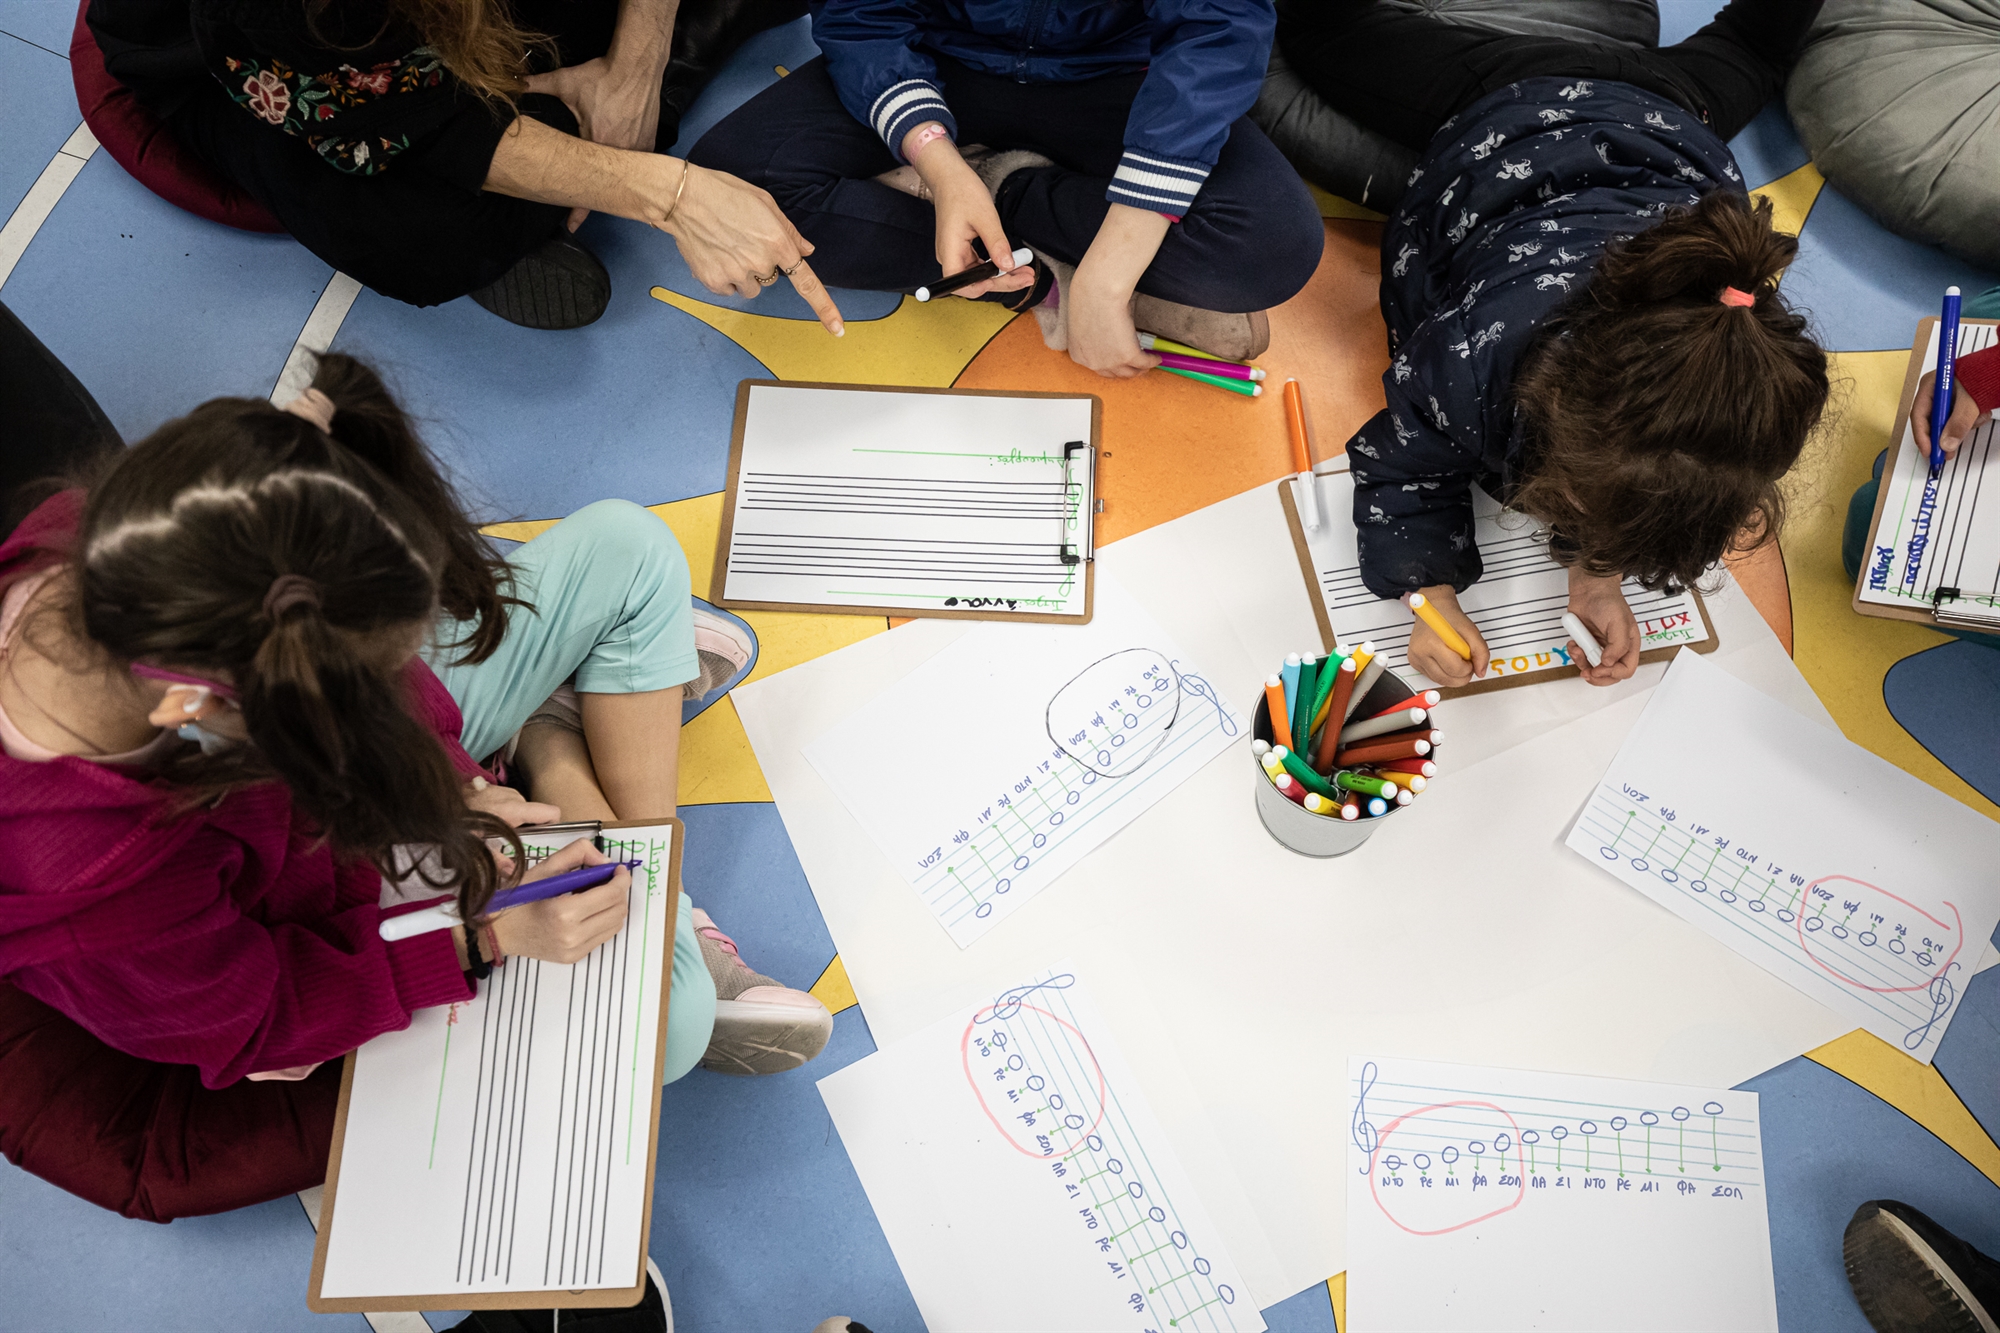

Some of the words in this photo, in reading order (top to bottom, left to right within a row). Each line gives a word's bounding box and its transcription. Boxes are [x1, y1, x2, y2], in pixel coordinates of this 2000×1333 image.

[1143, 665, 1159, 680] ΝΤΟ
[1014, 777, 1032, 793] ΝΤΟ
[1737, 848, 1758, 863] ΝΤΟ
[1922, 937, 1943, 953] ΝΤΟ
[974, 1038, 990, 1056] ΝΤΟ
[1080, 1208, 1098, 1229] ΝΤΟ
[1383, 1177, 1403, 1187] ΝΤΟ
[1584, 1178, 1605, 1189] ΝΤΟ
